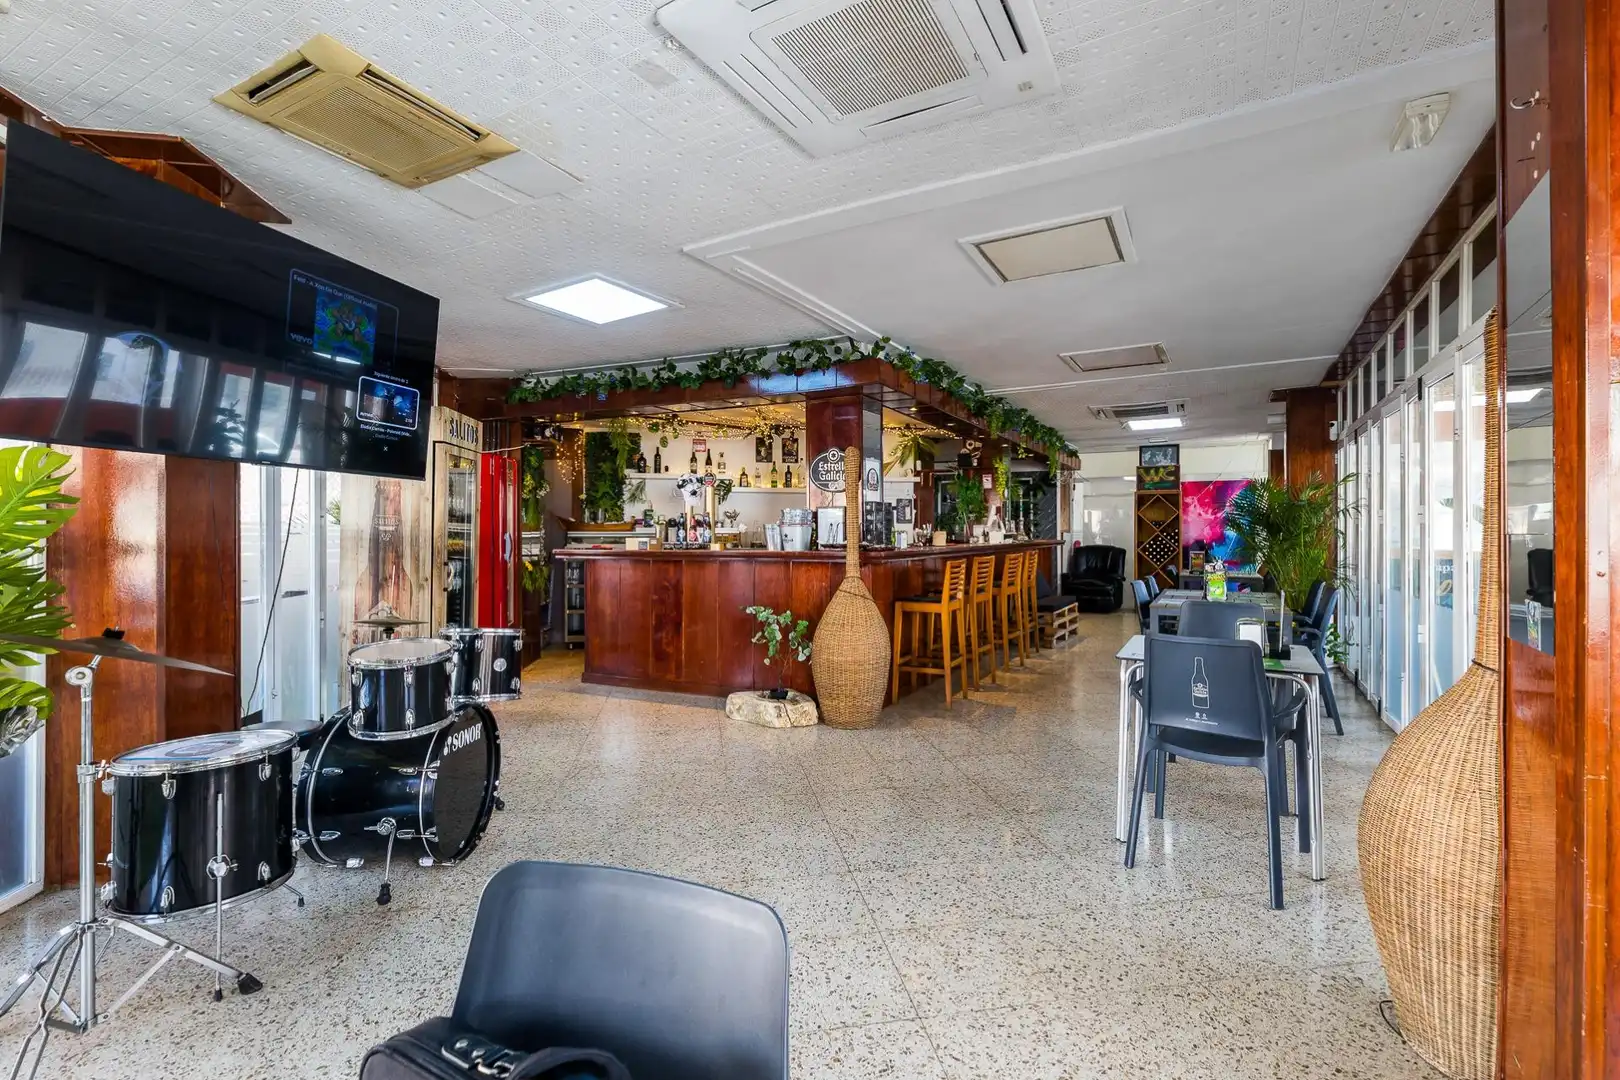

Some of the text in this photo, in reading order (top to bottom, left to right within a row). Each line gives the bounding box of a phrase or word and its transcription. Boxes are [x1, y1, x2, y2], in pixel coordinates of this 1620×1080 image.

[449, 416, 479, 446] SALITOS
[818, 461, 845, 471] Estrell
[1136, 465, 1176, 482] WC
[452, 721, 482, 752] SONOR
